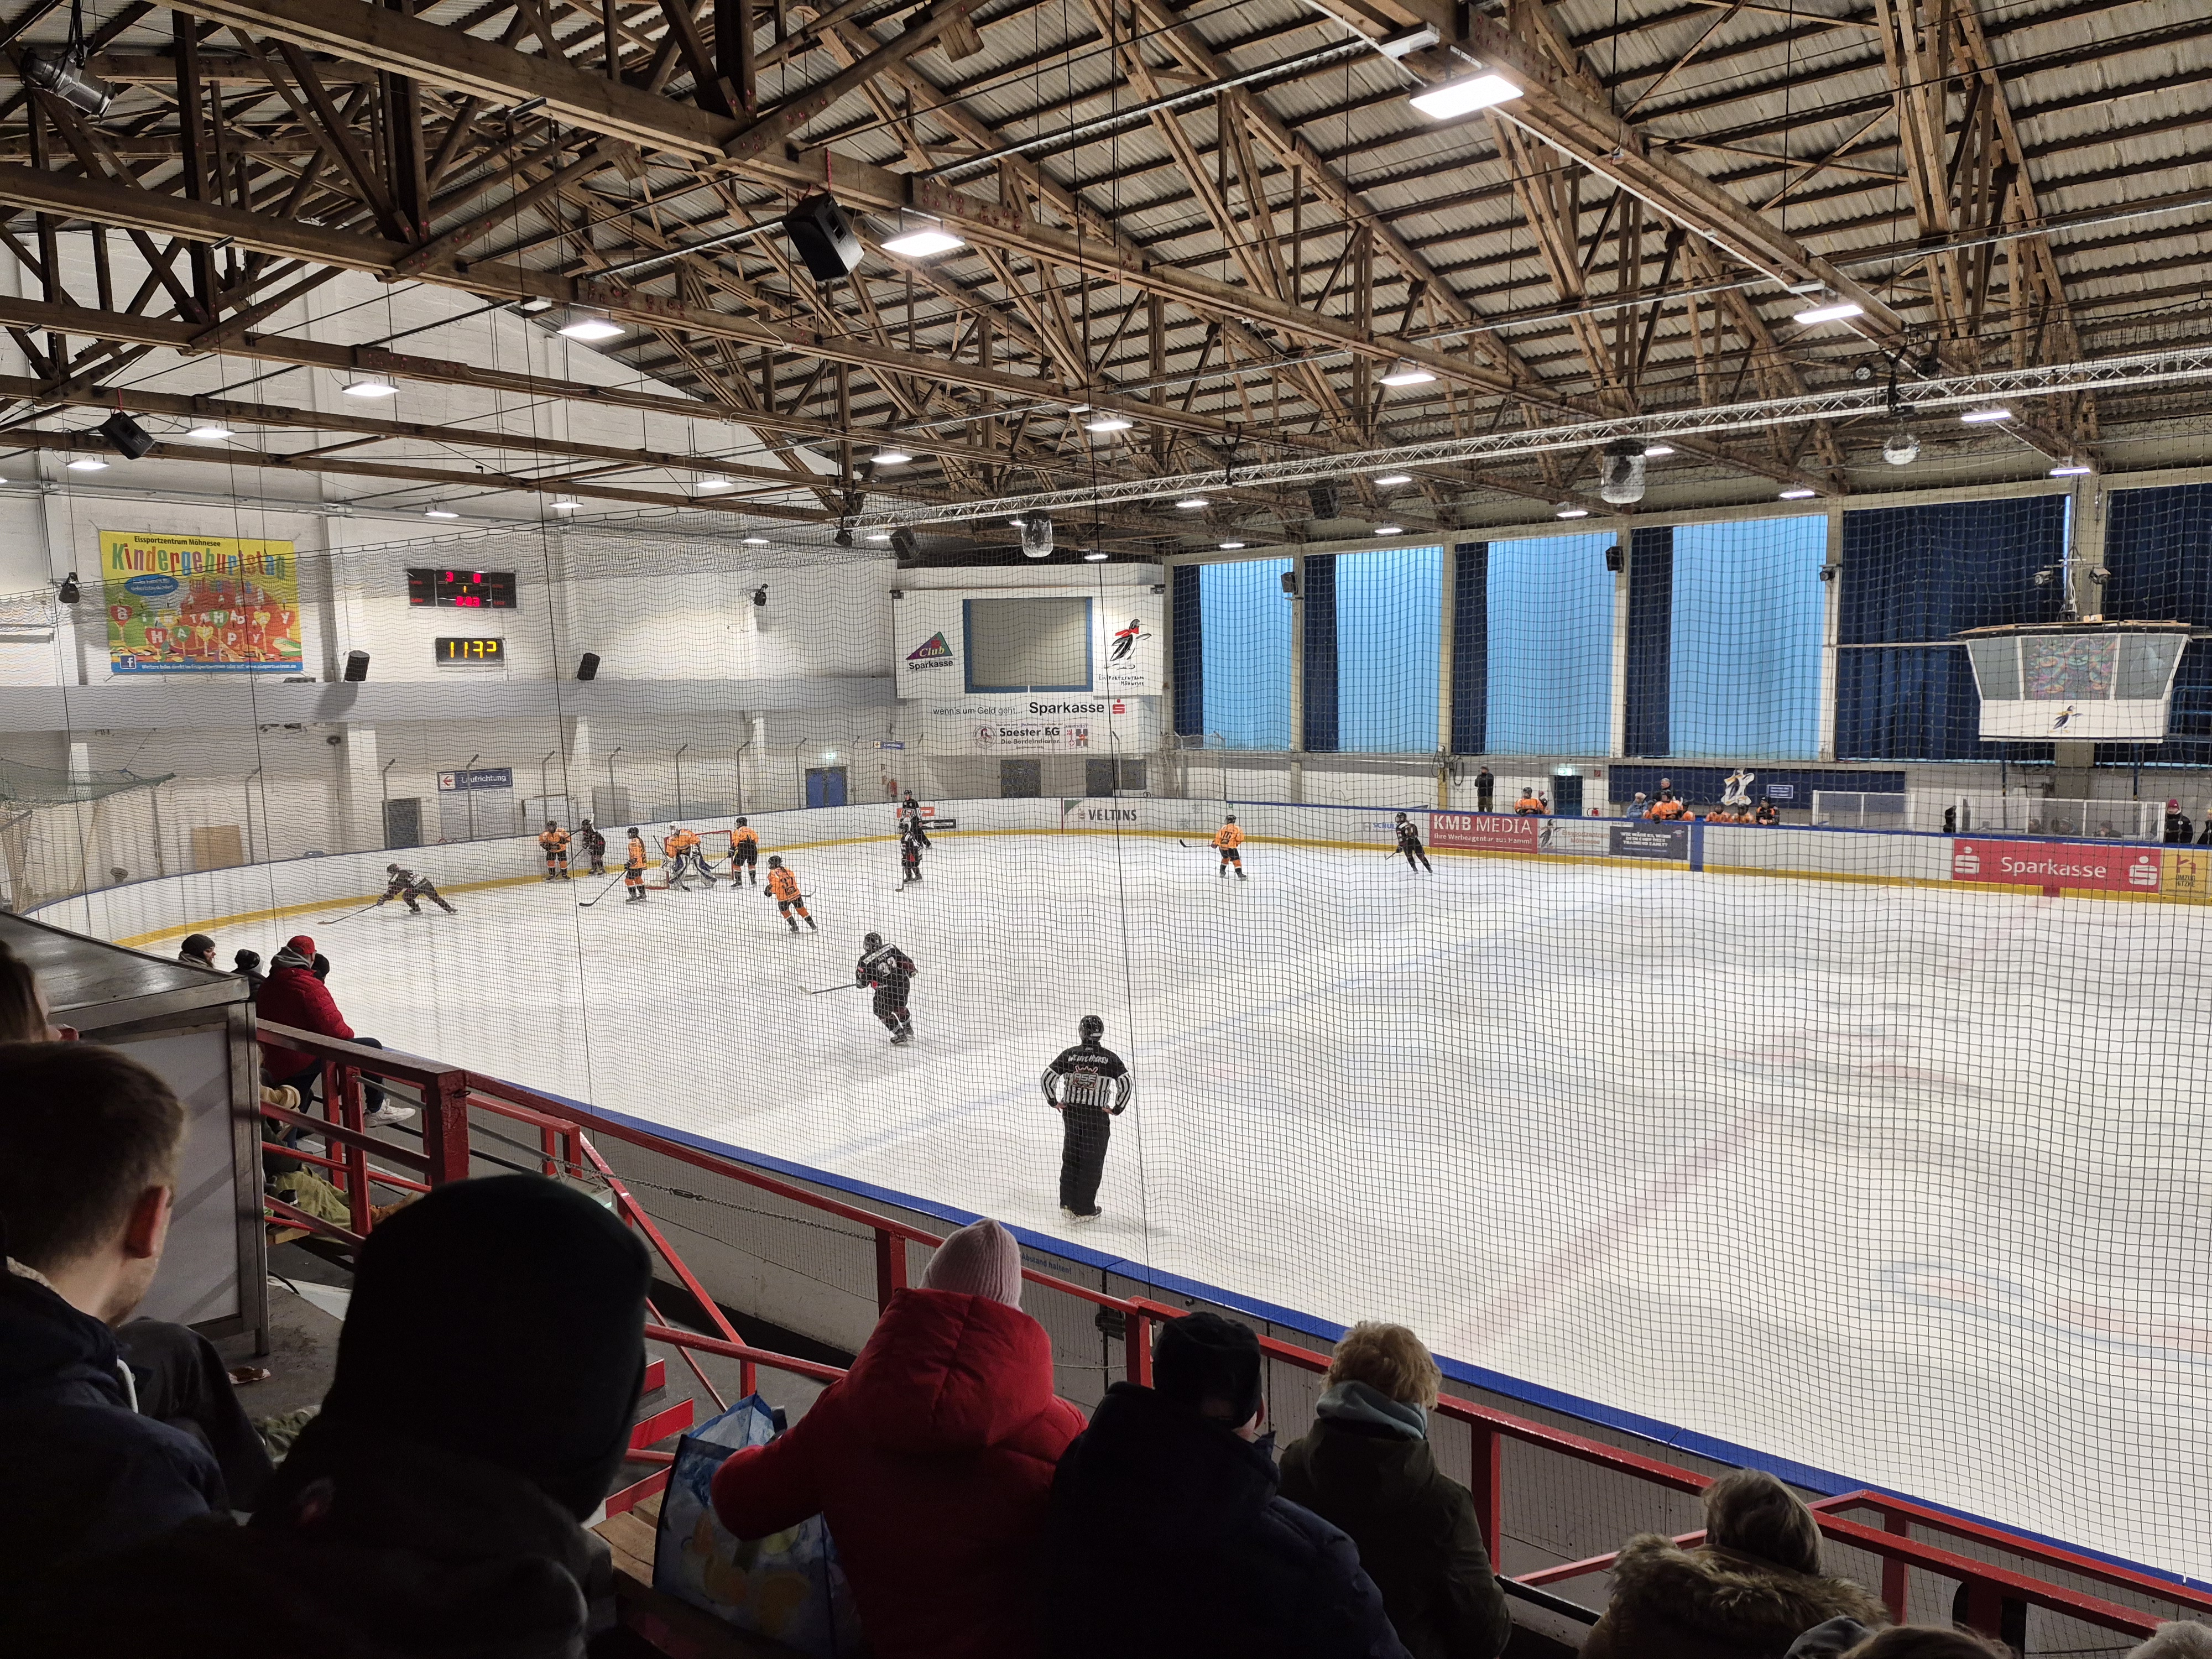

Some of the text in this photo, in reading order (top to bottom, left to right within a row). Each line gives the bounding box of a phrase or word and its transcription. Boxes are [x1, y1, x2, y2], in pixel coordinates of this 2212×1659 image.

[134, 536, 221, 547] Eissportzentrum Möhnesee
[112, 542, 285, 579] Kindergeburtstag
[446, 572, 453, 582] 3
[919, 646, 945, 656] Club
[909, 661, 953, 670] Sparkasse
[933, 707, 960, 715] wenn's
[1029, 701, 1104, 716] Sparkasse
[1000, 727, 1041, 736] Soester
[1088, 809, 1137, 821] VELTINS
[1434, 815, 1532, 834] KMB MEDIA
[1448, 834, 1493, 843] Werbeagentur
[2001, 857, 2106, 878] Sparkasse
[1089, 1054, 1109, 1064] HOCKEY
[1021, 1253, 1072, 1275] Abstand halten!
